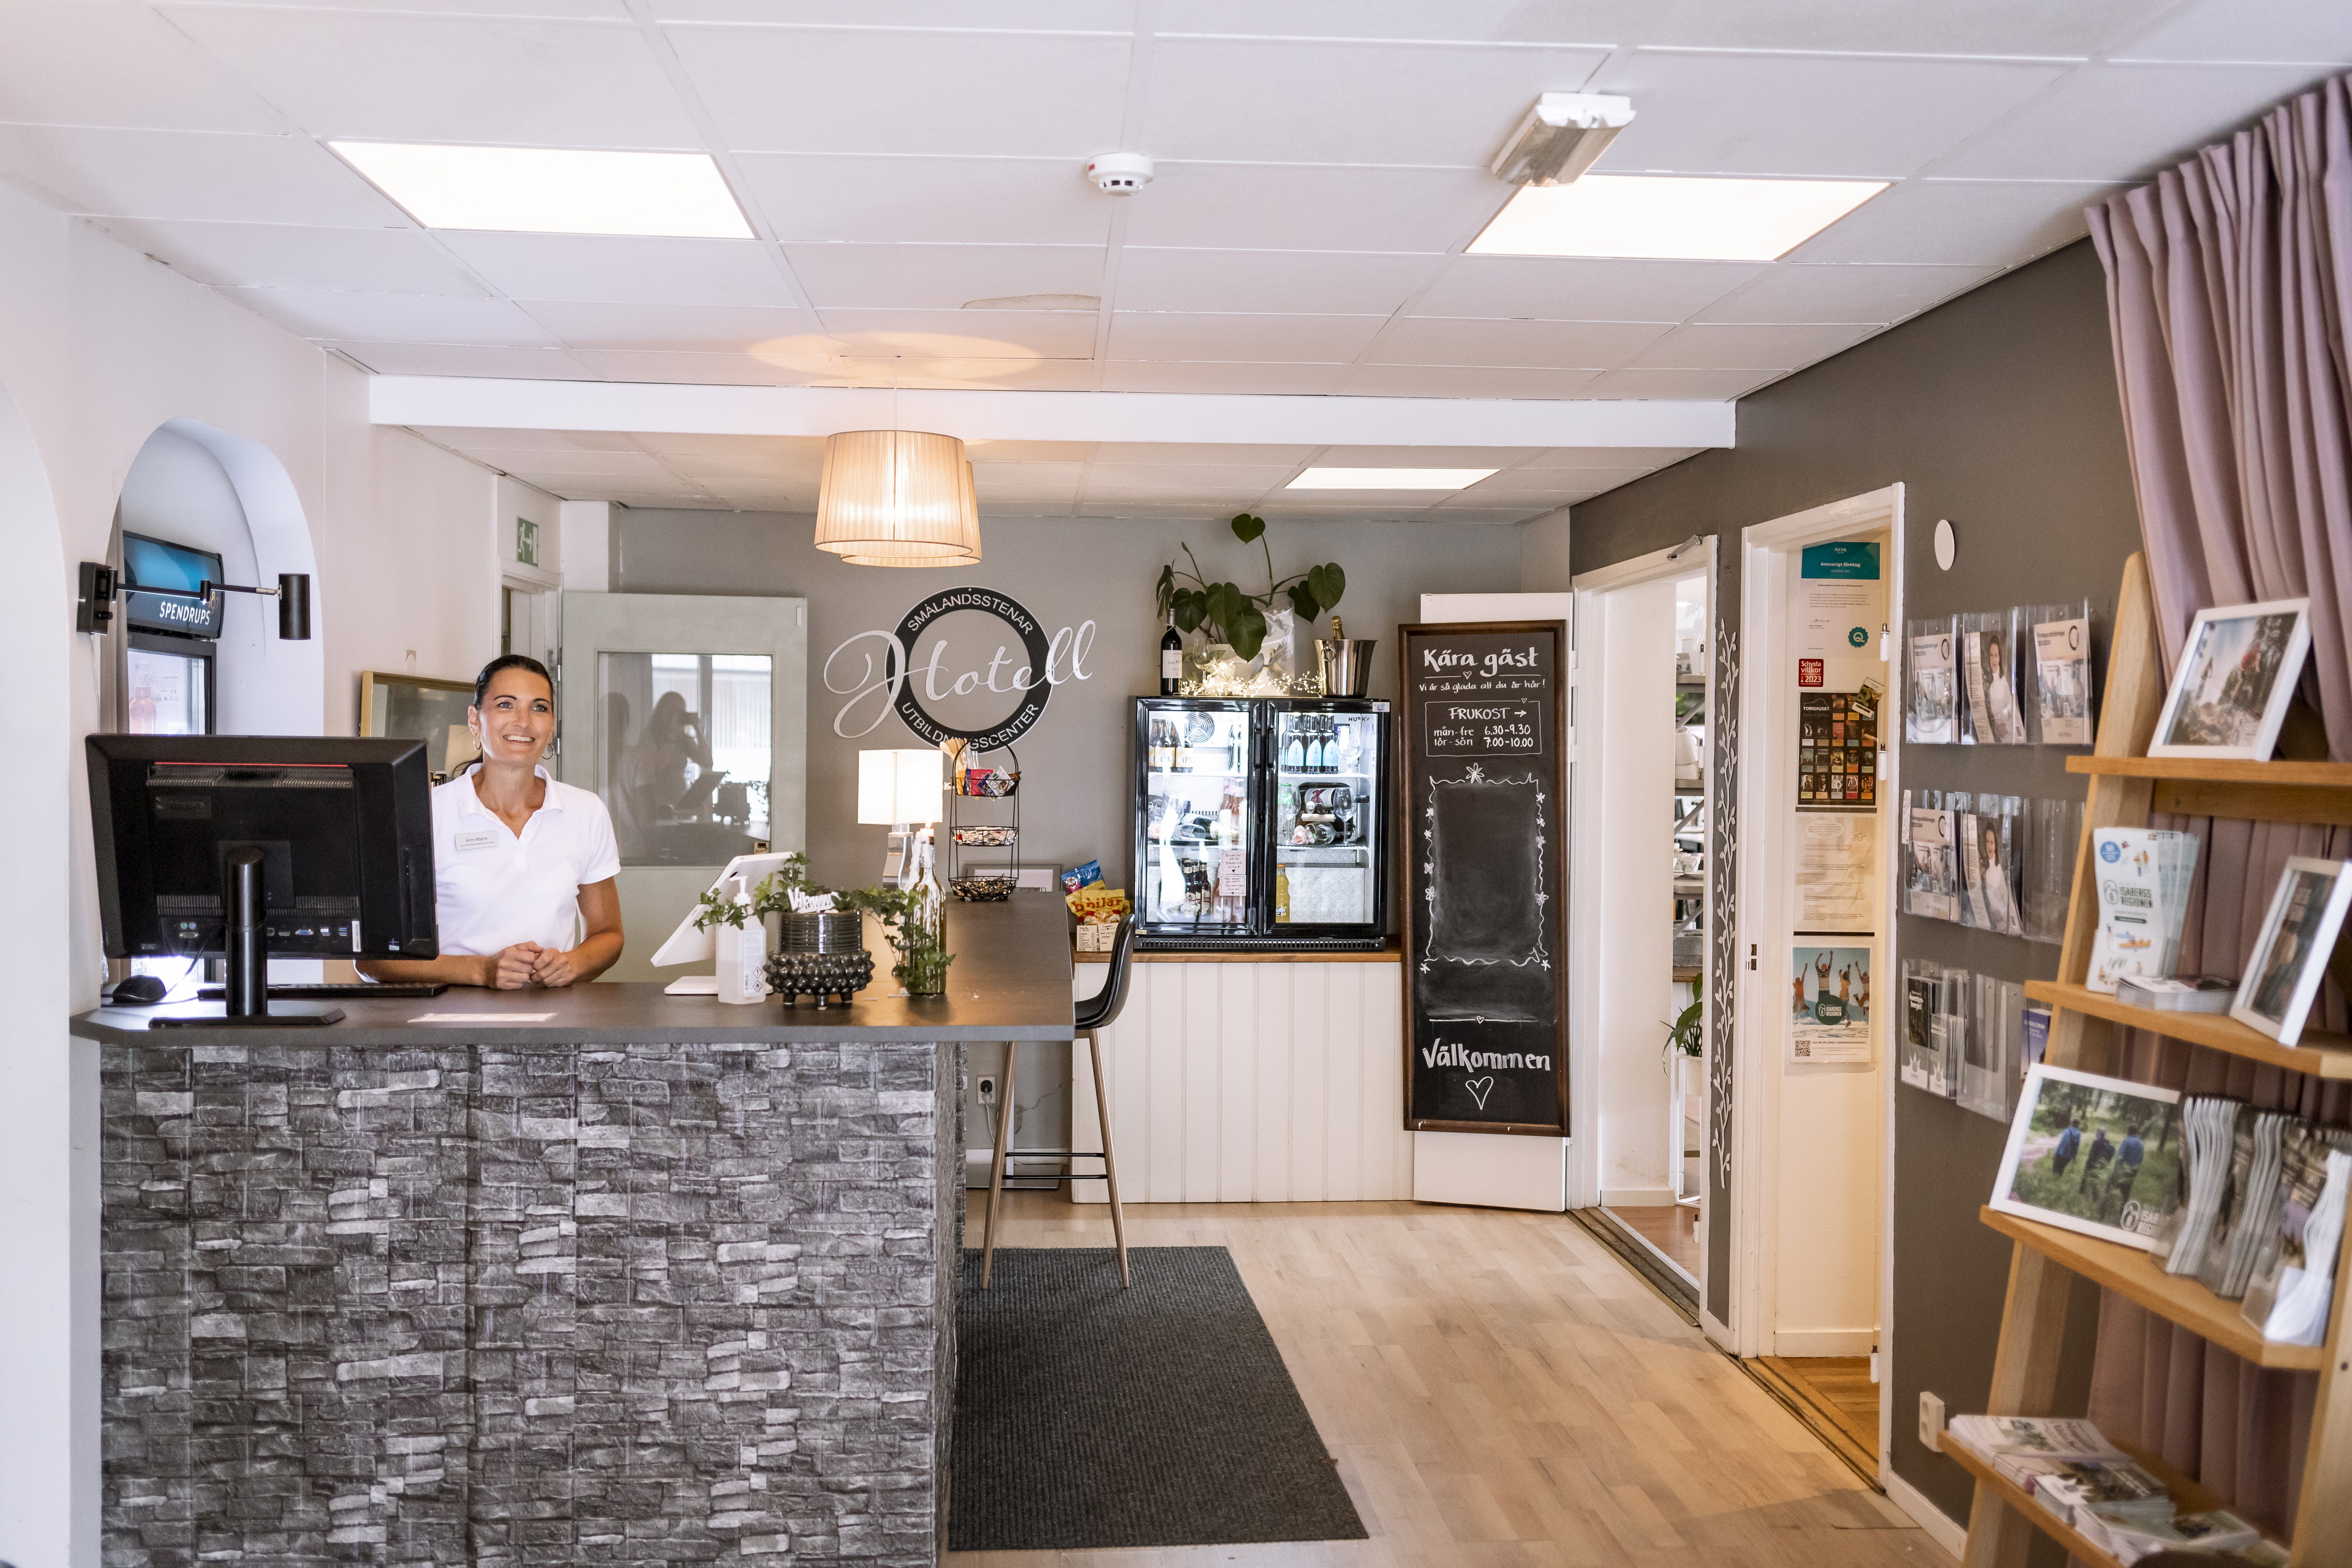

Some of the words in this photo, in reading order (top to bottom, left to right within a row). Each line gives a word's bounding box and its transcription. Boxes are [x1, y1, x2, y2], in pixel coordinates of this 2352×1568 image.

[159, 601, 210, 625] SPENDRUPS
[908, 593, 1034, 635] SMÅLANDSSTENAR
[1423, 649, 1479, 673] Kära
[1479, 646, 1539, 677] gäst
[823, 619, 1096, 738] Hotell
[1441, 682, 1450, 691] så
[1452, 682, 1477, 693] glada
[1448, 707, 1511, 720] FRUKOST
[1485, 724, 1531, 736] 6.30-9.30
[1483, 737, 1534, 748] 7.00-10.00
[1086, 897, 1122, 908] bilar
[1422, 1038, 1551, 1073] Välkommen
